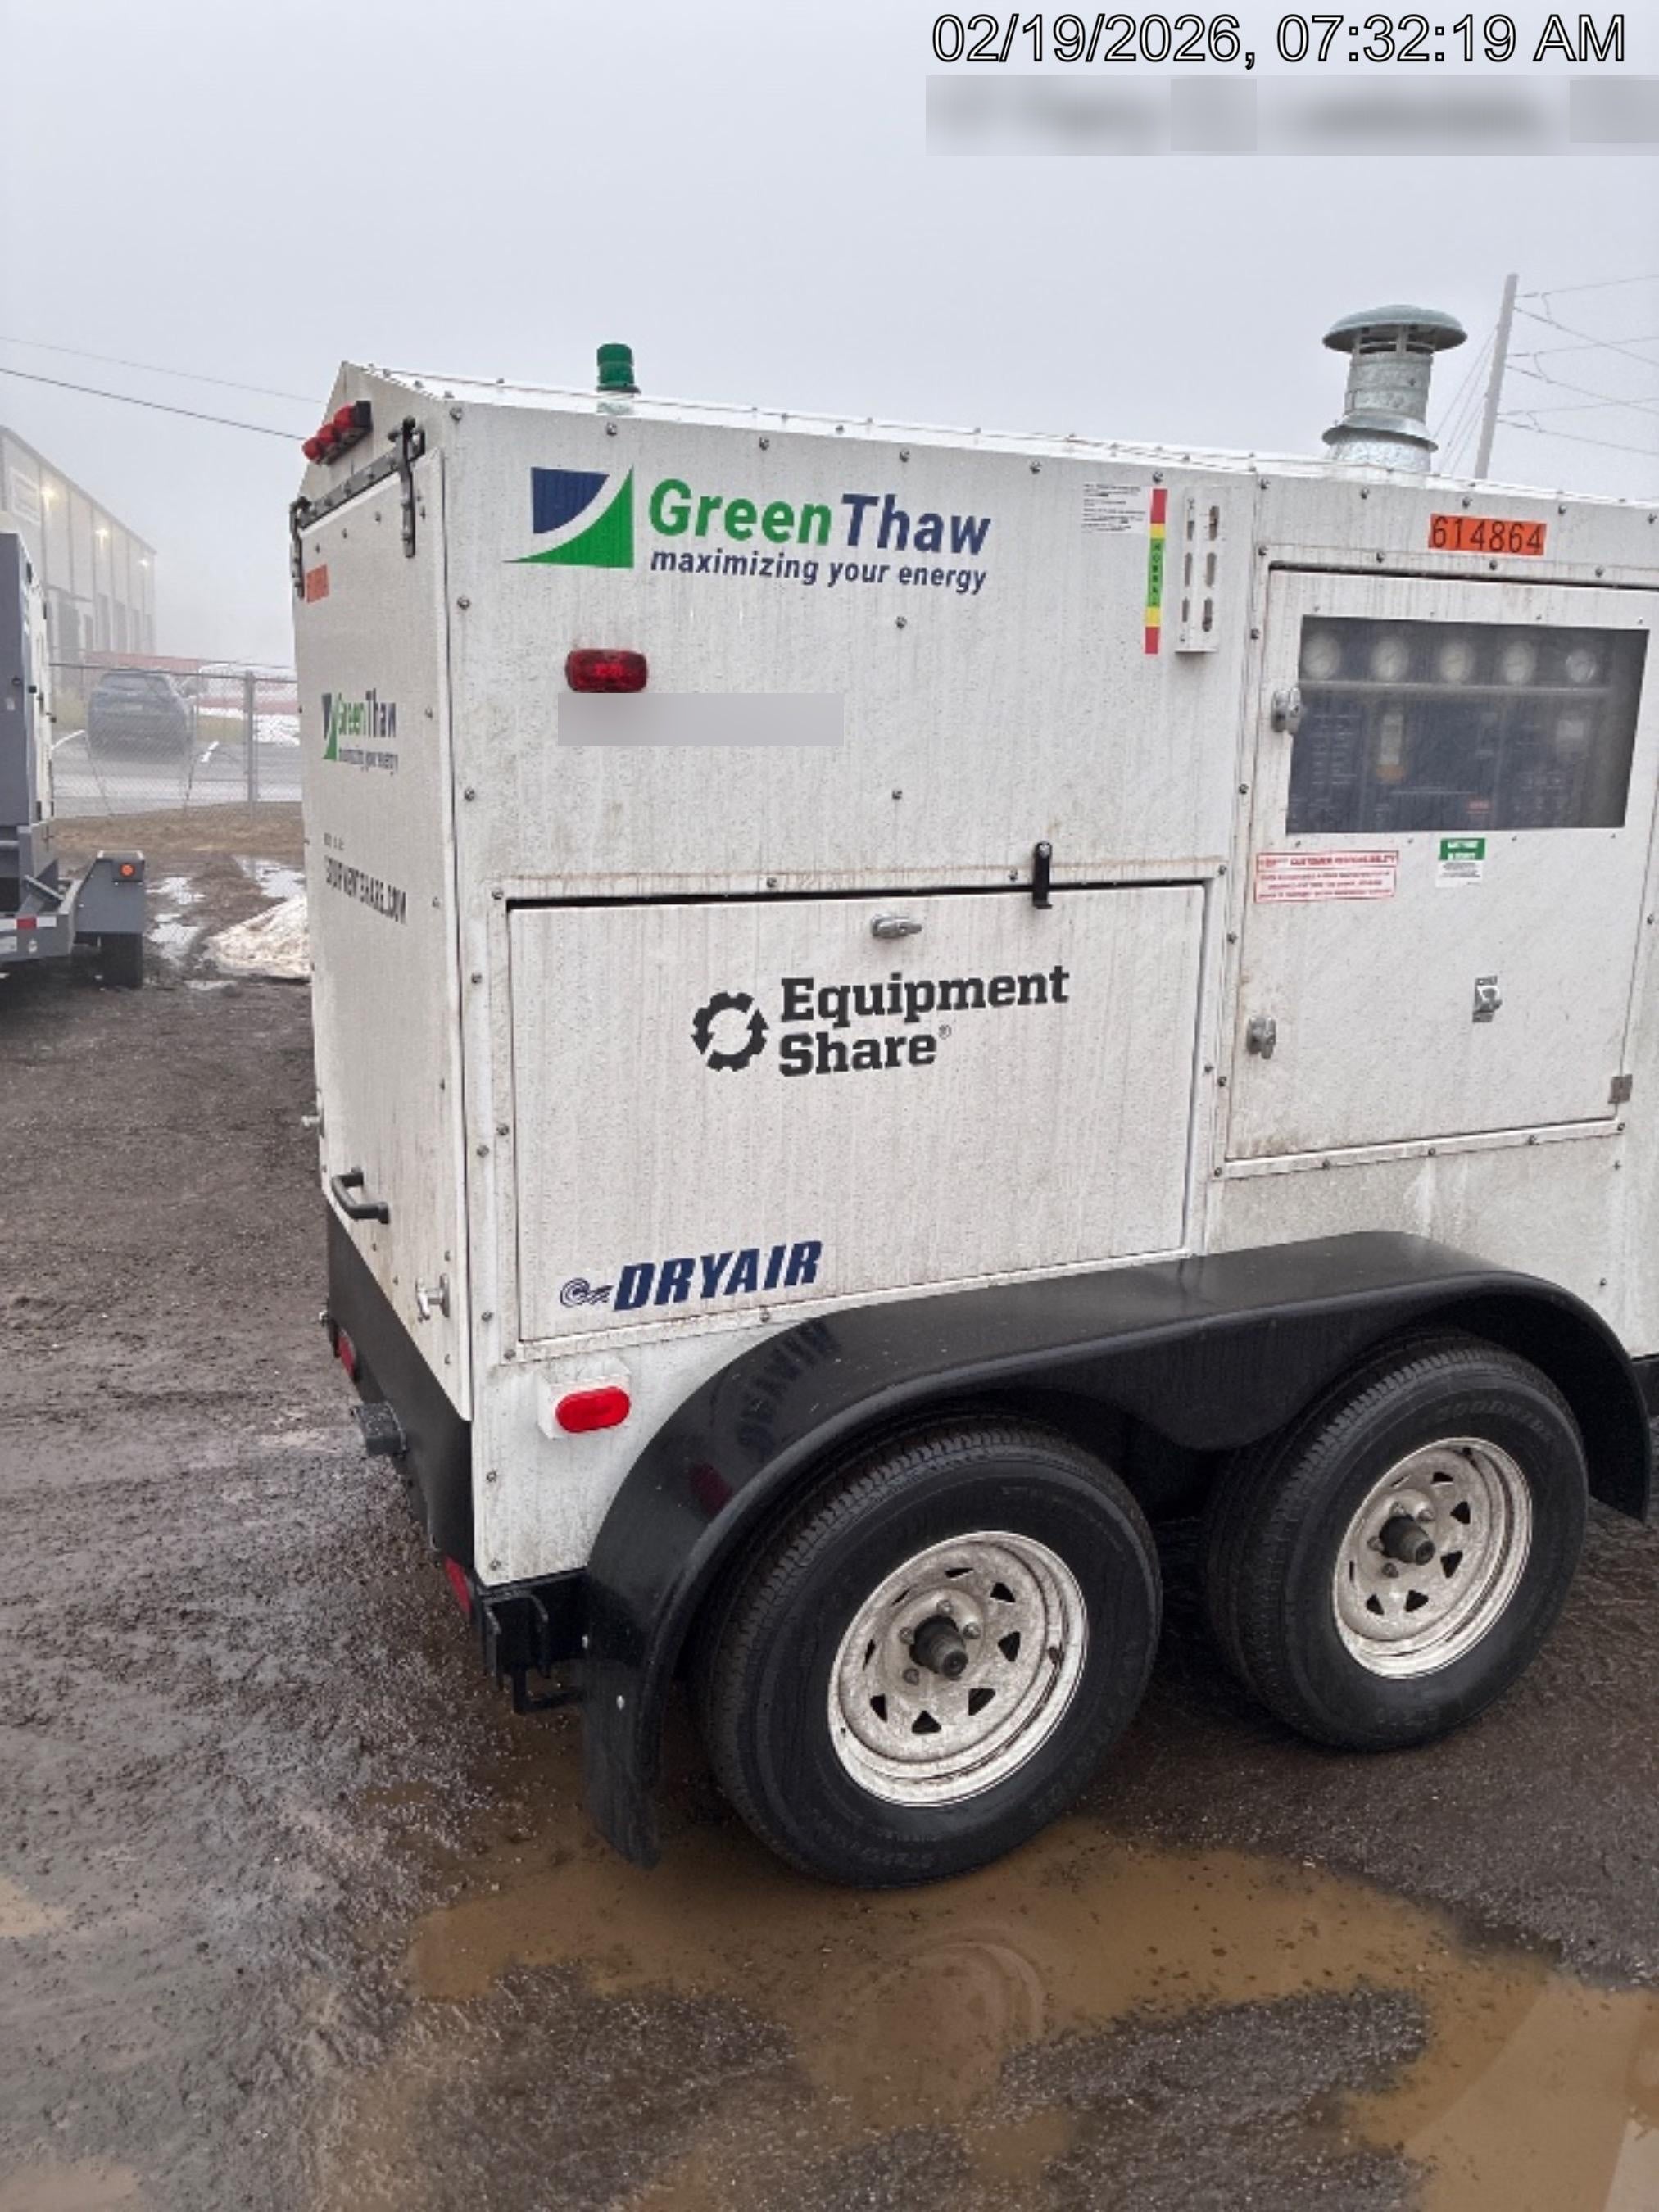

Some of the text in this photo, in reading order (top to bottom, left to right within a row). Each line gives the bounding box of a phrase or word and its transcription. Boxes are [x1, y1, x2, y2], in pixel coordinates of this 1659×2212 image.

[1432, 515, 1542, 555] 614864
[650, 548, 986, 596] maximizing your energy
[781, 965, 1070, 1028] Equipment
[614, 1240, 823, 1312] DRYAIR
